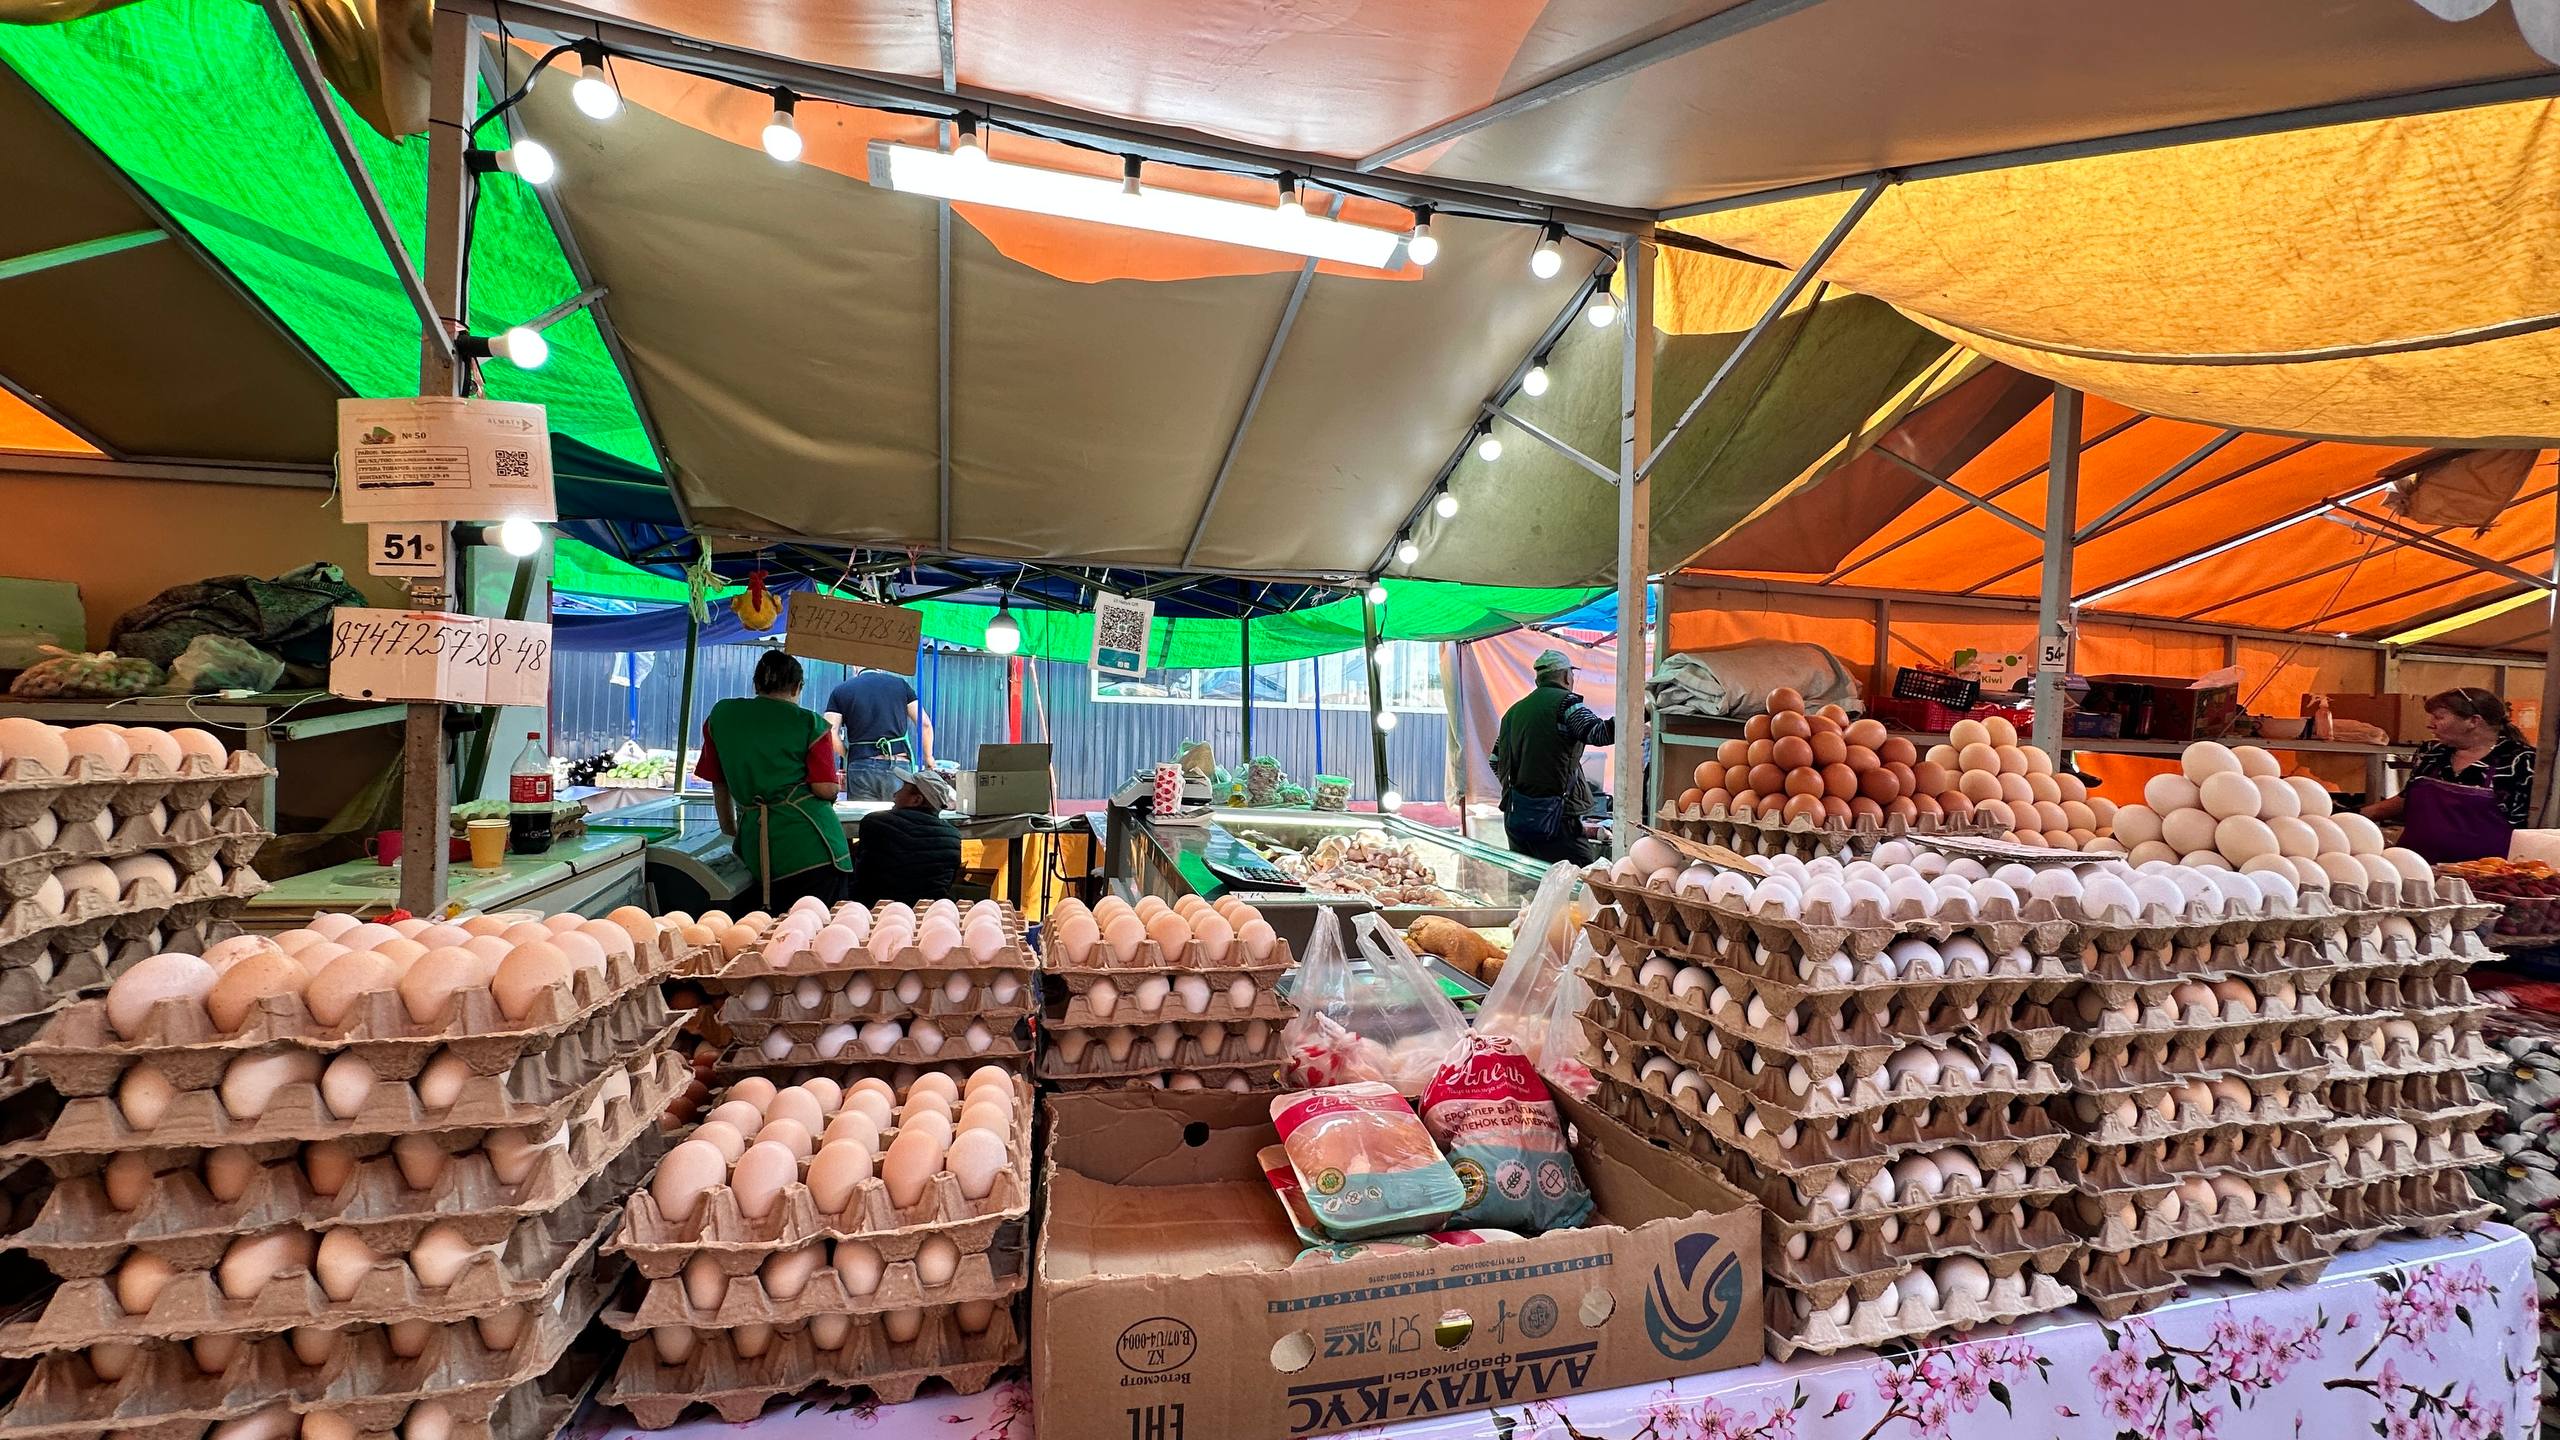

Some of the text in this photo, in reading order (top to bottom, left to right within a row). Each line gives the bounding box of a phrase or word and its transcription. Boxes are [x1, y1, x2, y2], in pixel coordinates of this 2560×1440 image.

[414, 432, 427, 440] 50
[2045, 646, 2063, 662] 54
[1981, 675, 2003, 685] Kiwi
[1271, 1255, 1611, 1312] ПРОИЗВЕДЕНО В КАЗАХСТАНЕ
[1324, 1331, 1367, 1358] KZ
[1147, 1349, 1165, 1365] KZ
[1387, 1350, 1512, 1382] фабрикасы
[1120, 1372, 1192, 1387] Ветосмотр
